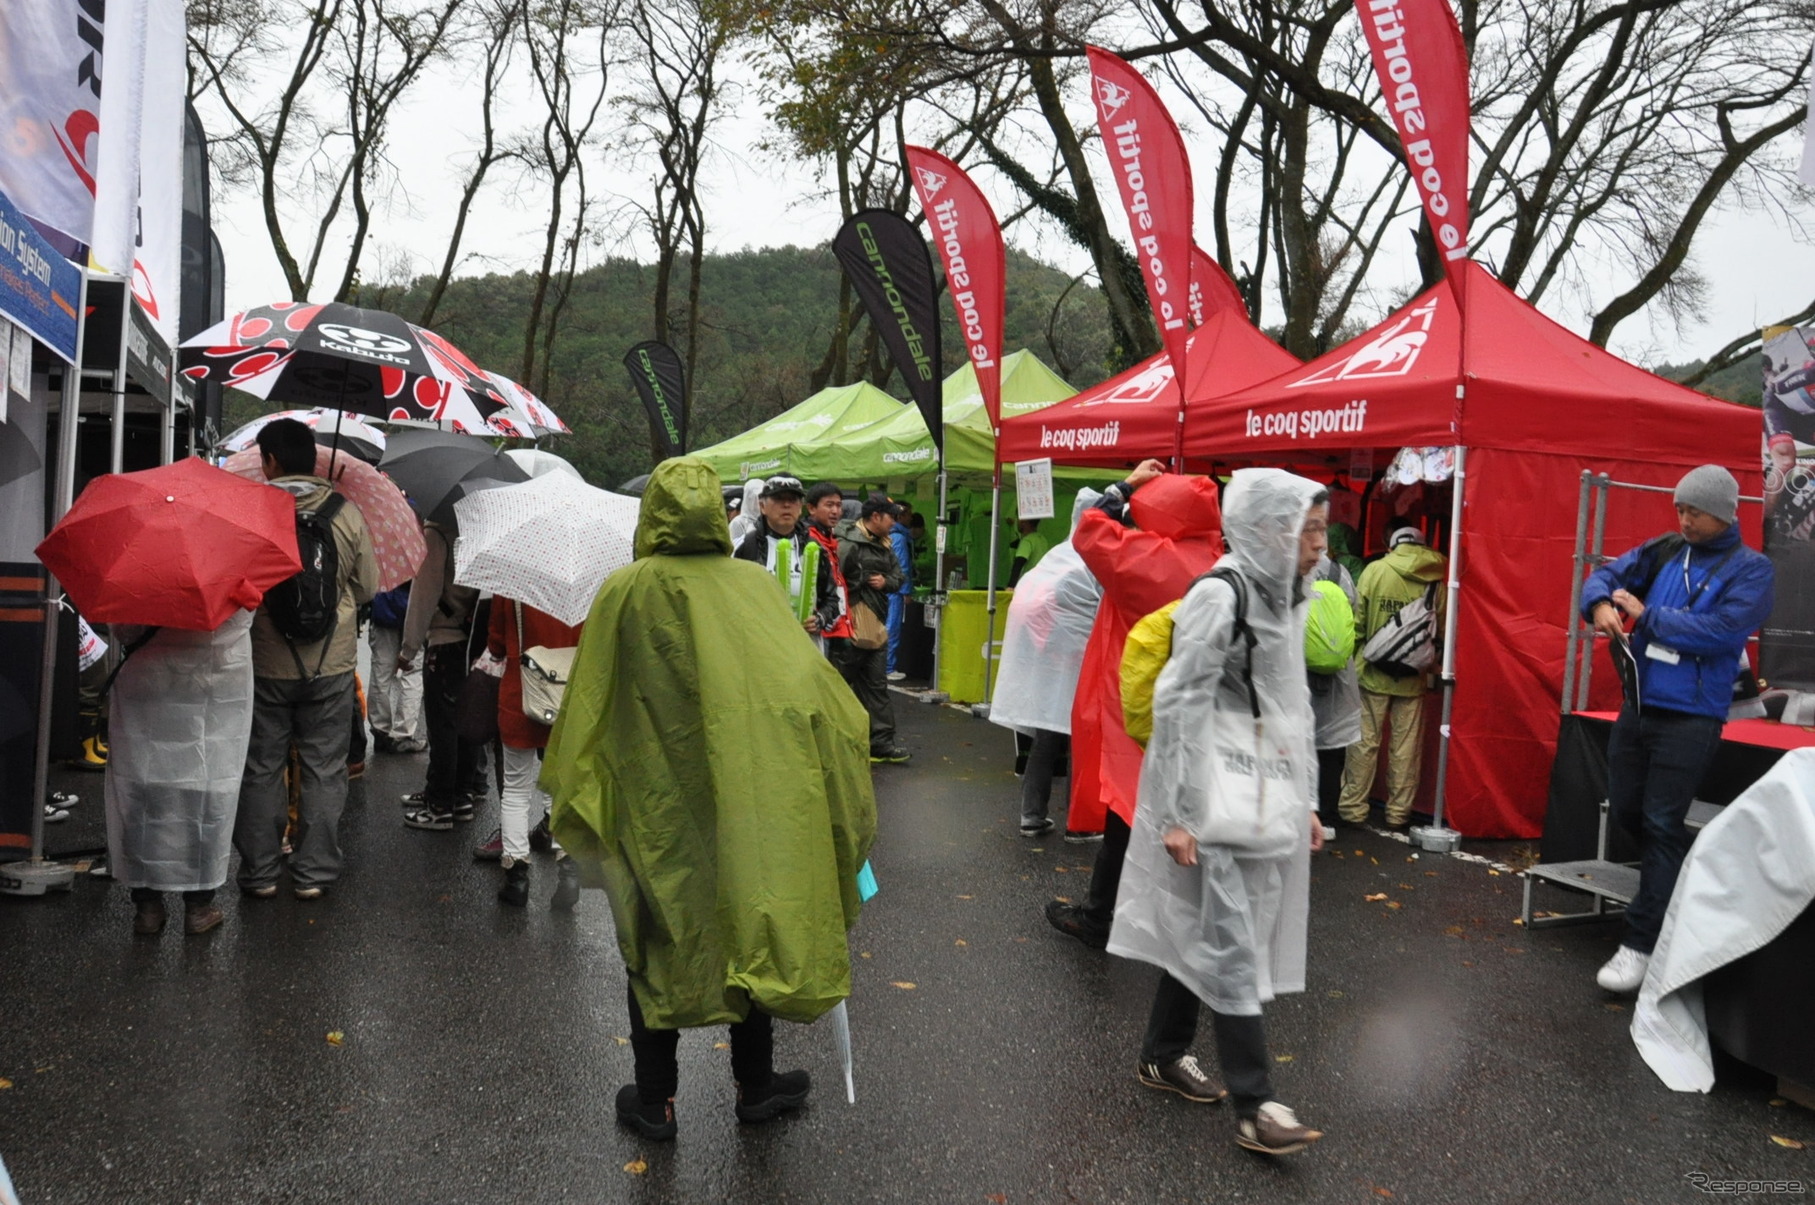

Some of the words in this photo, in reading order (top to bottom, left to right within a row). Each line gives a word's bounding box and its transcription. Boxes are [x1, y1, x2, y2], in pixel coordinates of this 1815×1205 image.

[16, 229, 51, 288] System
[856, 221, 933, 381] cannondale
[319, 339, 411, 366] Kabuto
[638, 349, 680, 445] cannondale
[1245, 408, 1262, 438] le
[1263, 411, 1299, 439] coq
[1299, 399, 1368, 439] sportif
[1040, 424, 1053, 448] le
[1053, 428, 1076, 451] coq
[1076, 420, 1120, 451] sportif
